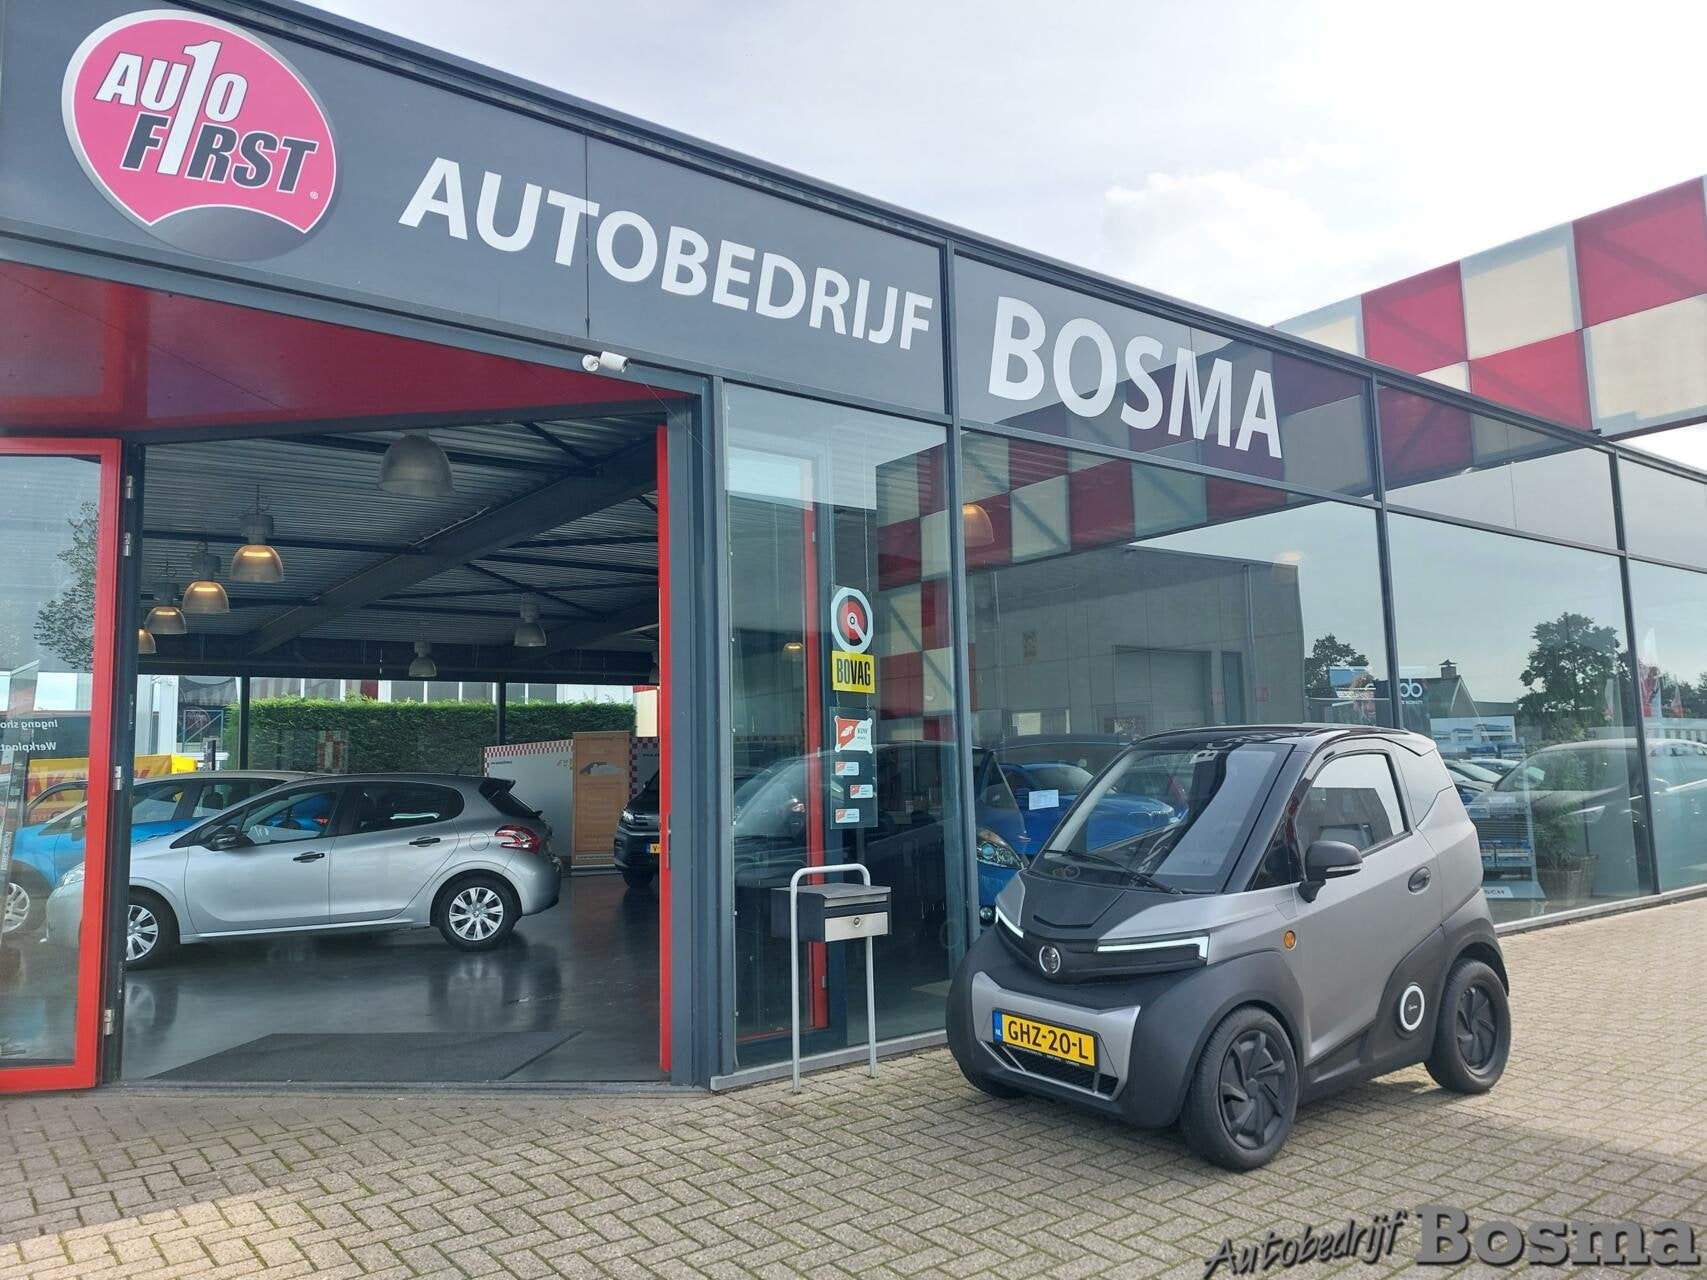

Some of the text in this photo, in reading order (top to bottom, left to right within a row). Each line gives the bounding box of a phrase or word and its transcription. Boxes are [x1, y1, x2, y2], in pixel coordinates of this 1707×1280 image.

[398, 157, 1282, 459] AUTOBEDRIJF BOSMA
[836, 658, 871, 686] BOVAG
[1008, 1020, 1089, 1060] GHZ-20-L
